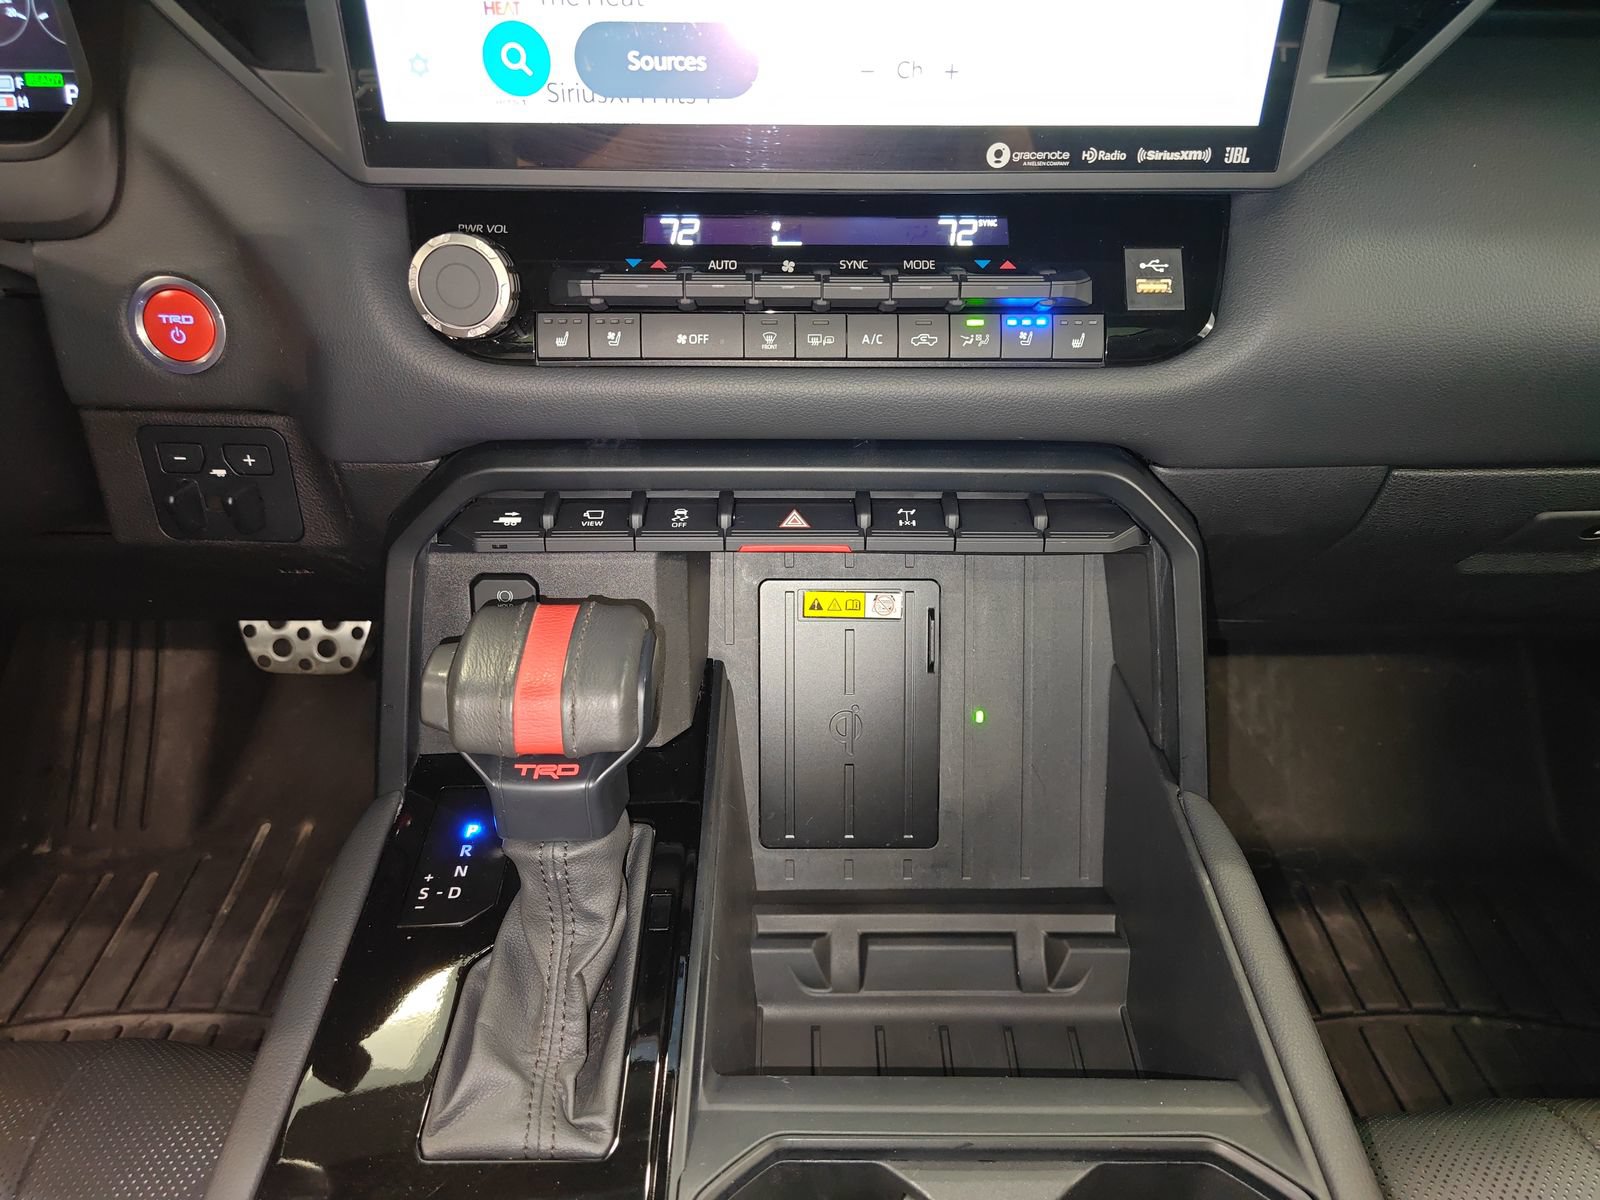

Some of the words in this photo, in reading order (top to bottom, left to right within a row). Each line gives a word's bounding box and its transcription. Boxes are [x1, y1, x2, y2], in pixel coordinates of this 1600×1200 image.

[483, 1, 520, 15] HEAT
[627, 50, 708, 72] Sources
[897, 60, 923, 79] Ch
[65, 83, 79, 105] P
[1012, 150, 1070, 162] gracenote
[1098, 149, 1127, 161] Radio
[1225, 147, 1250, 164] JBL
[458, 223, 483, 233] PWR
[486, 224, 509, 234] VOL
[659, 217, 701, 246] 72
[938, 218, 978, 246] 72
[978, 218, 998, 227] SYNC
[708, 259, 738, 271] AUTO
[839, 259, 869, 271] SYNC
[903, 259, 936, 271] MODE
[158, 313, 195, 324] TRD
[688, 334, 710, 345] OFF
[861, 332, 883, 345] A/C
[514, 763, 580, 780] TRD
[465, 824, 479, 838] P
[459, 844, 473, 857] R
[453, 865, 468, 878] N
[417, 887, 430, 900] S
[447, 886, 462, 900] D
